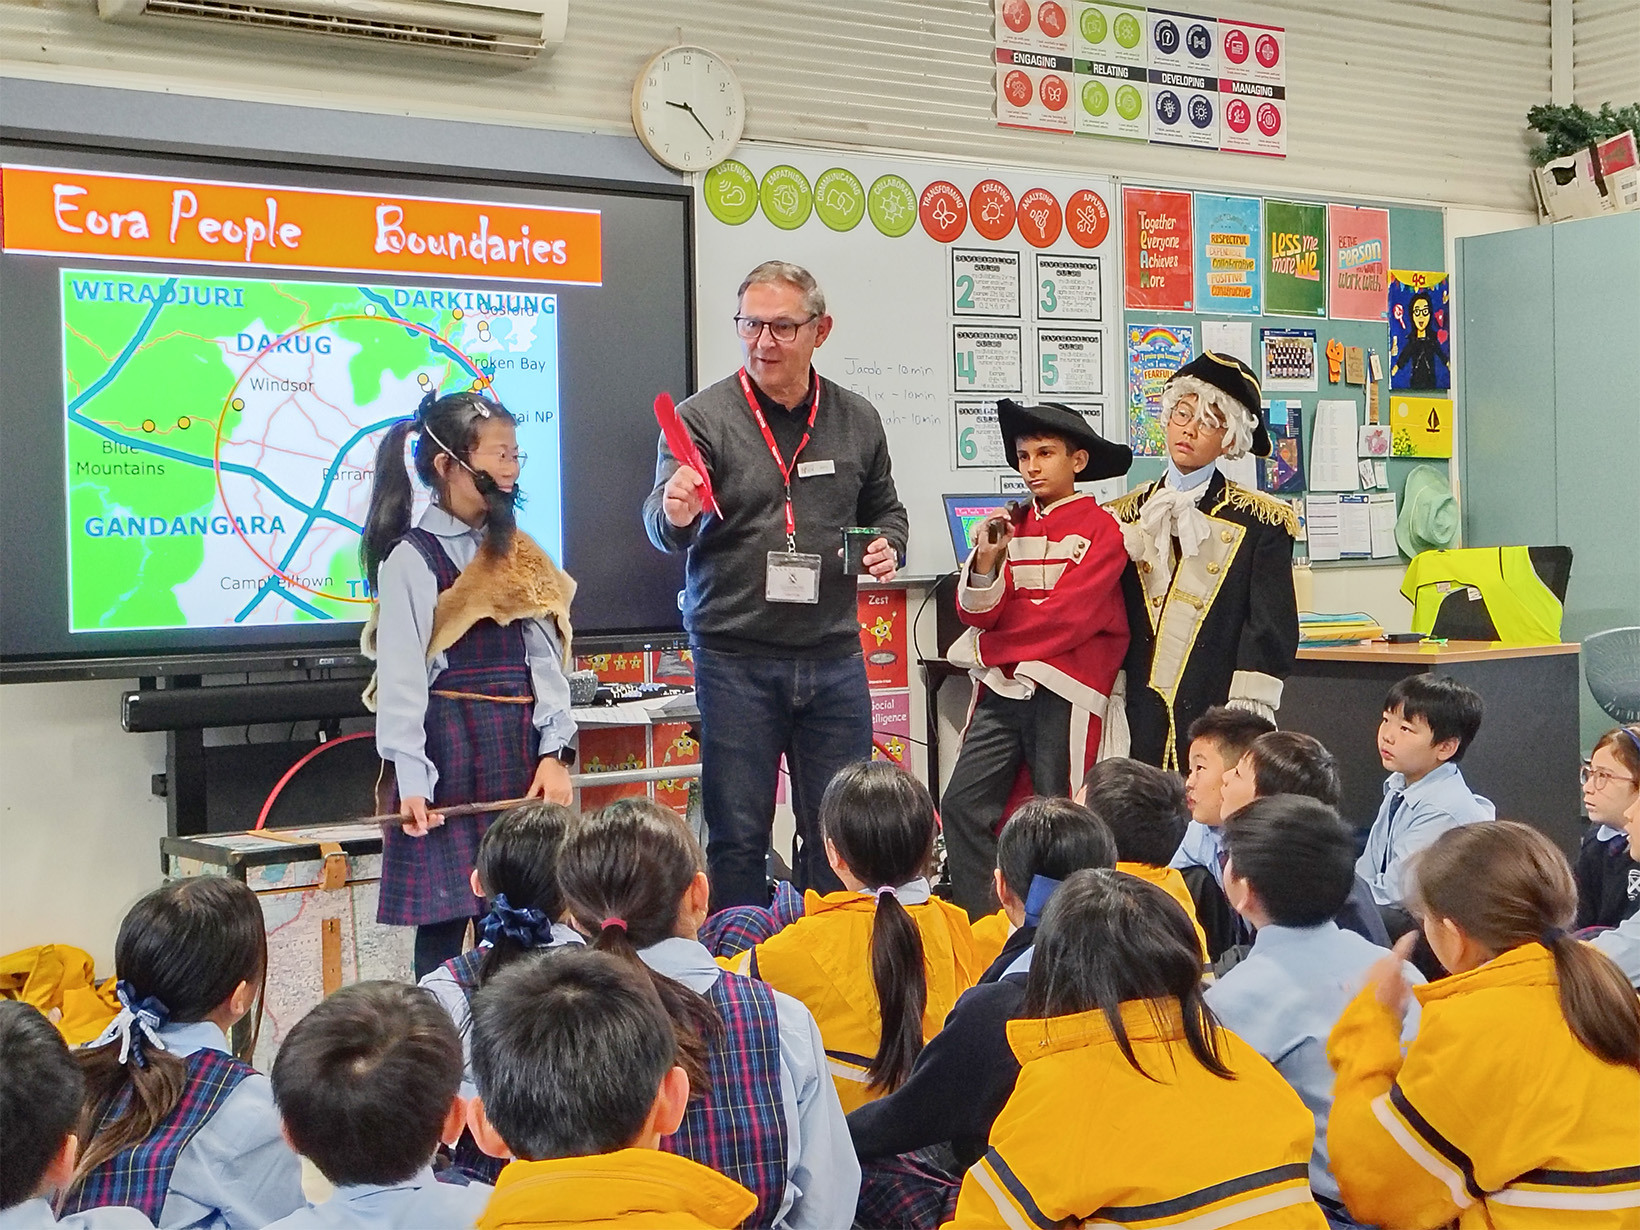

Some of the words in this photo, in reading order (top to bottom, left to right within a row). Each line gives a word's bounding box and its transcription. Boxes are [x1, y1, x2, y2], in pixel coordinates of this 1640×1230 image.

[663, 62, 670, 71] 11
[683, 55, 691, 65] 12
[707, 64, 711, 73] 1
[1013, 52, 1057, 68] ENGAGING
[1093, 63, 1129, 78] RELATING
[649, 78, 657, 87] 10
[720, 82, 726, 92] 2
[1161, 72, 1205, 89] DEVELOPING
[1232, 81, 1273, 97] MANAGING
[643, 102, 649, 111] 9
[726, 106, 732, 116] 3
[649, 127, 655, 136] 8
[719, 130, 724, 140] 4
[665, 143, 670, 153] 7
[684, 151, 690, 161] 6
[706, 147, 712, 157] 5
[715, 163, 752, 183] LISTENING
[767, 169, 808, 193] EMPATHISING
[817, 171, 861, 202] COMMUNICATING
[873, 178, 914, 211] COLLABORATING
[981, 183, 1010, 203] CREATING
[922, 184, 964, 209] TRANSFORMING
[1022, 192, 1053, 210] ANALYSING
[1083, 193, 1106, 219] APPLYING
[53, 184, 149, 236] Eora
[169, 190, 302, 261] People
[375, 203, 567, 265] Boundaries
[1138, 211, 1176, 233] Together
[1211, 234, 1248, 245] RESPECTFUL
[1302, 235, 1319, 252] me
[1140, 250, 1178, 269] Achieves
[1272, 256, 1296, 274] more
[1140, 271, 1165, 288] More
[72, 280, 245, 308] WIRADJURI
[956, 274, 975, 308] 2
[1041, 279, 1058, 312] 3
[394, 289, 555, 314] DARKINJUNG
[237, 333, 332, 354] DARUG
[466, 356, 514, 370] Broken
[520, 357, 546, 375] Bay
[844, 357, 882, 375] Jacob
[957, 350, 977, 384] 4
[1042, 353, 1059, 386] 5
[250, 378, 314, 392] Windsor
[535, 411, 553, 423] NP
[103, 440, 139, 454] Blue
[960, 426, 978, 460] 6
[76, 461, 165, 477] Mountains
[85, 515, 286, 536] GANDANGARA
[868, 594, 889, 605] Zest
[872, 699, 895, 711] Social
